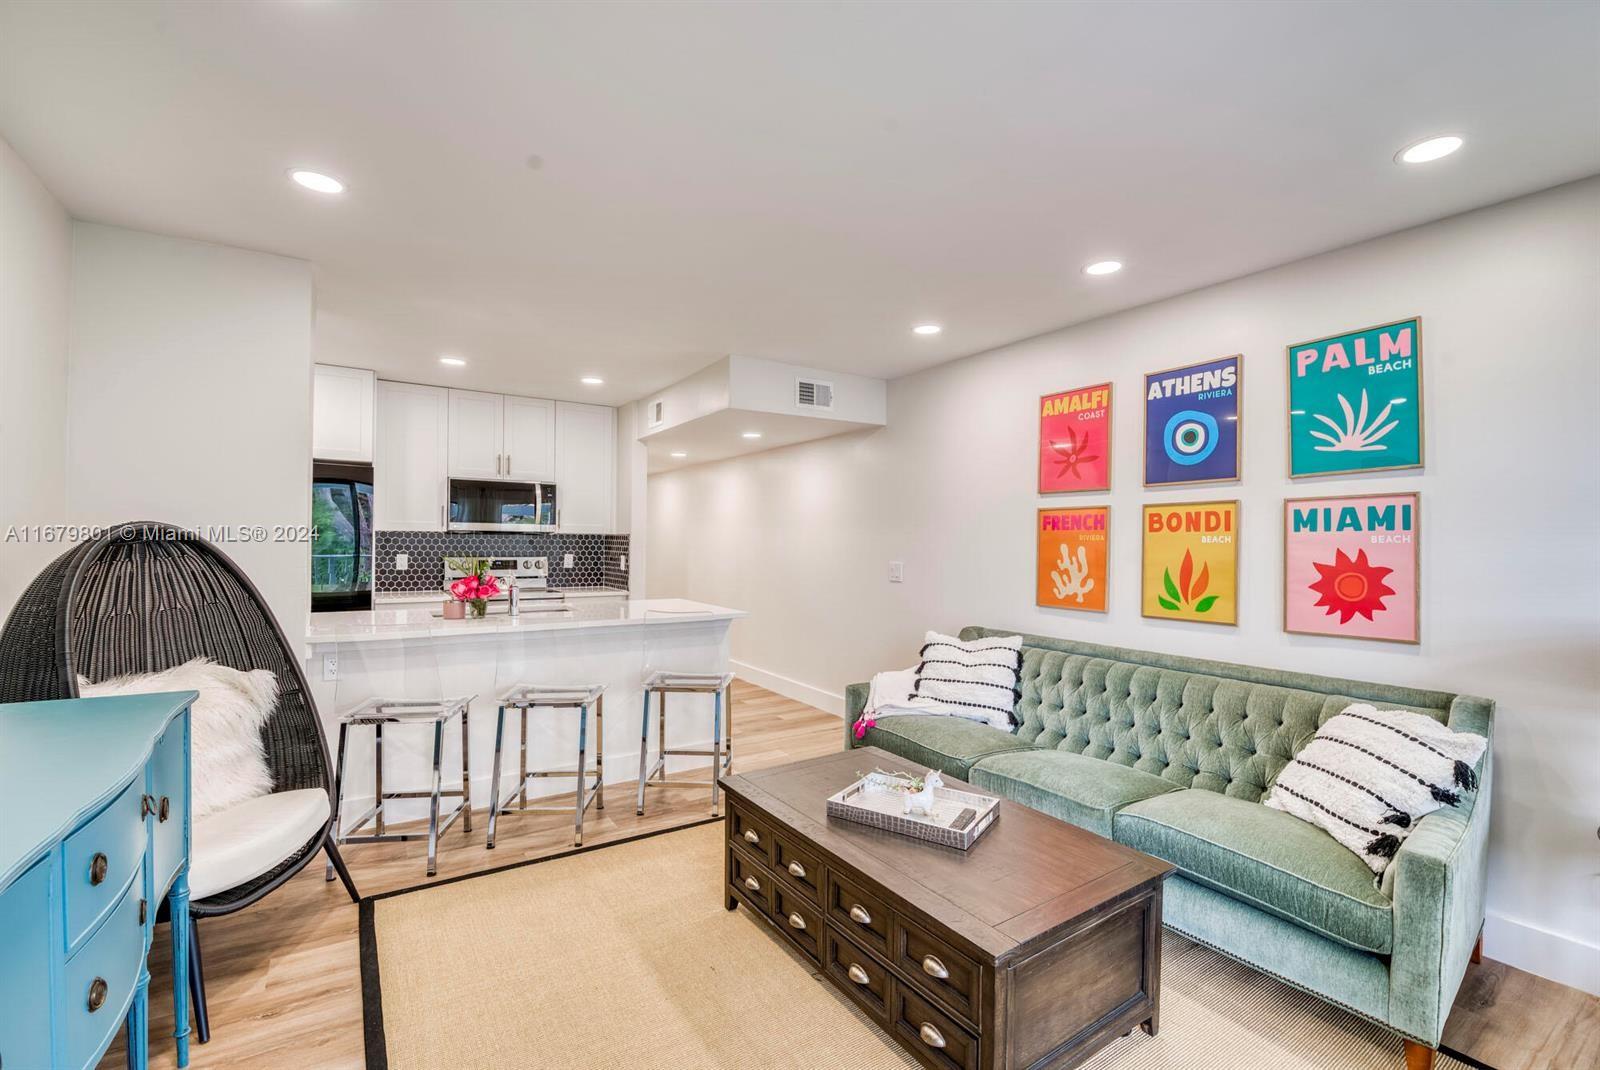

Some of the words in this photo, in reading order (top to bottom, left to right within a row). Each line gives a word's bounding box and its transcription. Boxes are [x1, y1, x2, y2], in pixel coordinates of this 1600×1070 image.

[1297, 328, 1411, 377] PALM
[1368, 359, 1411, 375] BEACH
[1148, 366, 1236, 400] ATHENS
[1042, 390, 1108, 416] AMALFI
[1198, 388, 1232, 400] RIVIERA
[1078, 409, 1105, 420] COAST
[1042, 514, 1104, 530] FRENCH
[1148, 510, 1231, 532] BONDI
[1293, 504, 1411, 532] MIAMI
[1370, 535, 1411, 544] BEACH
